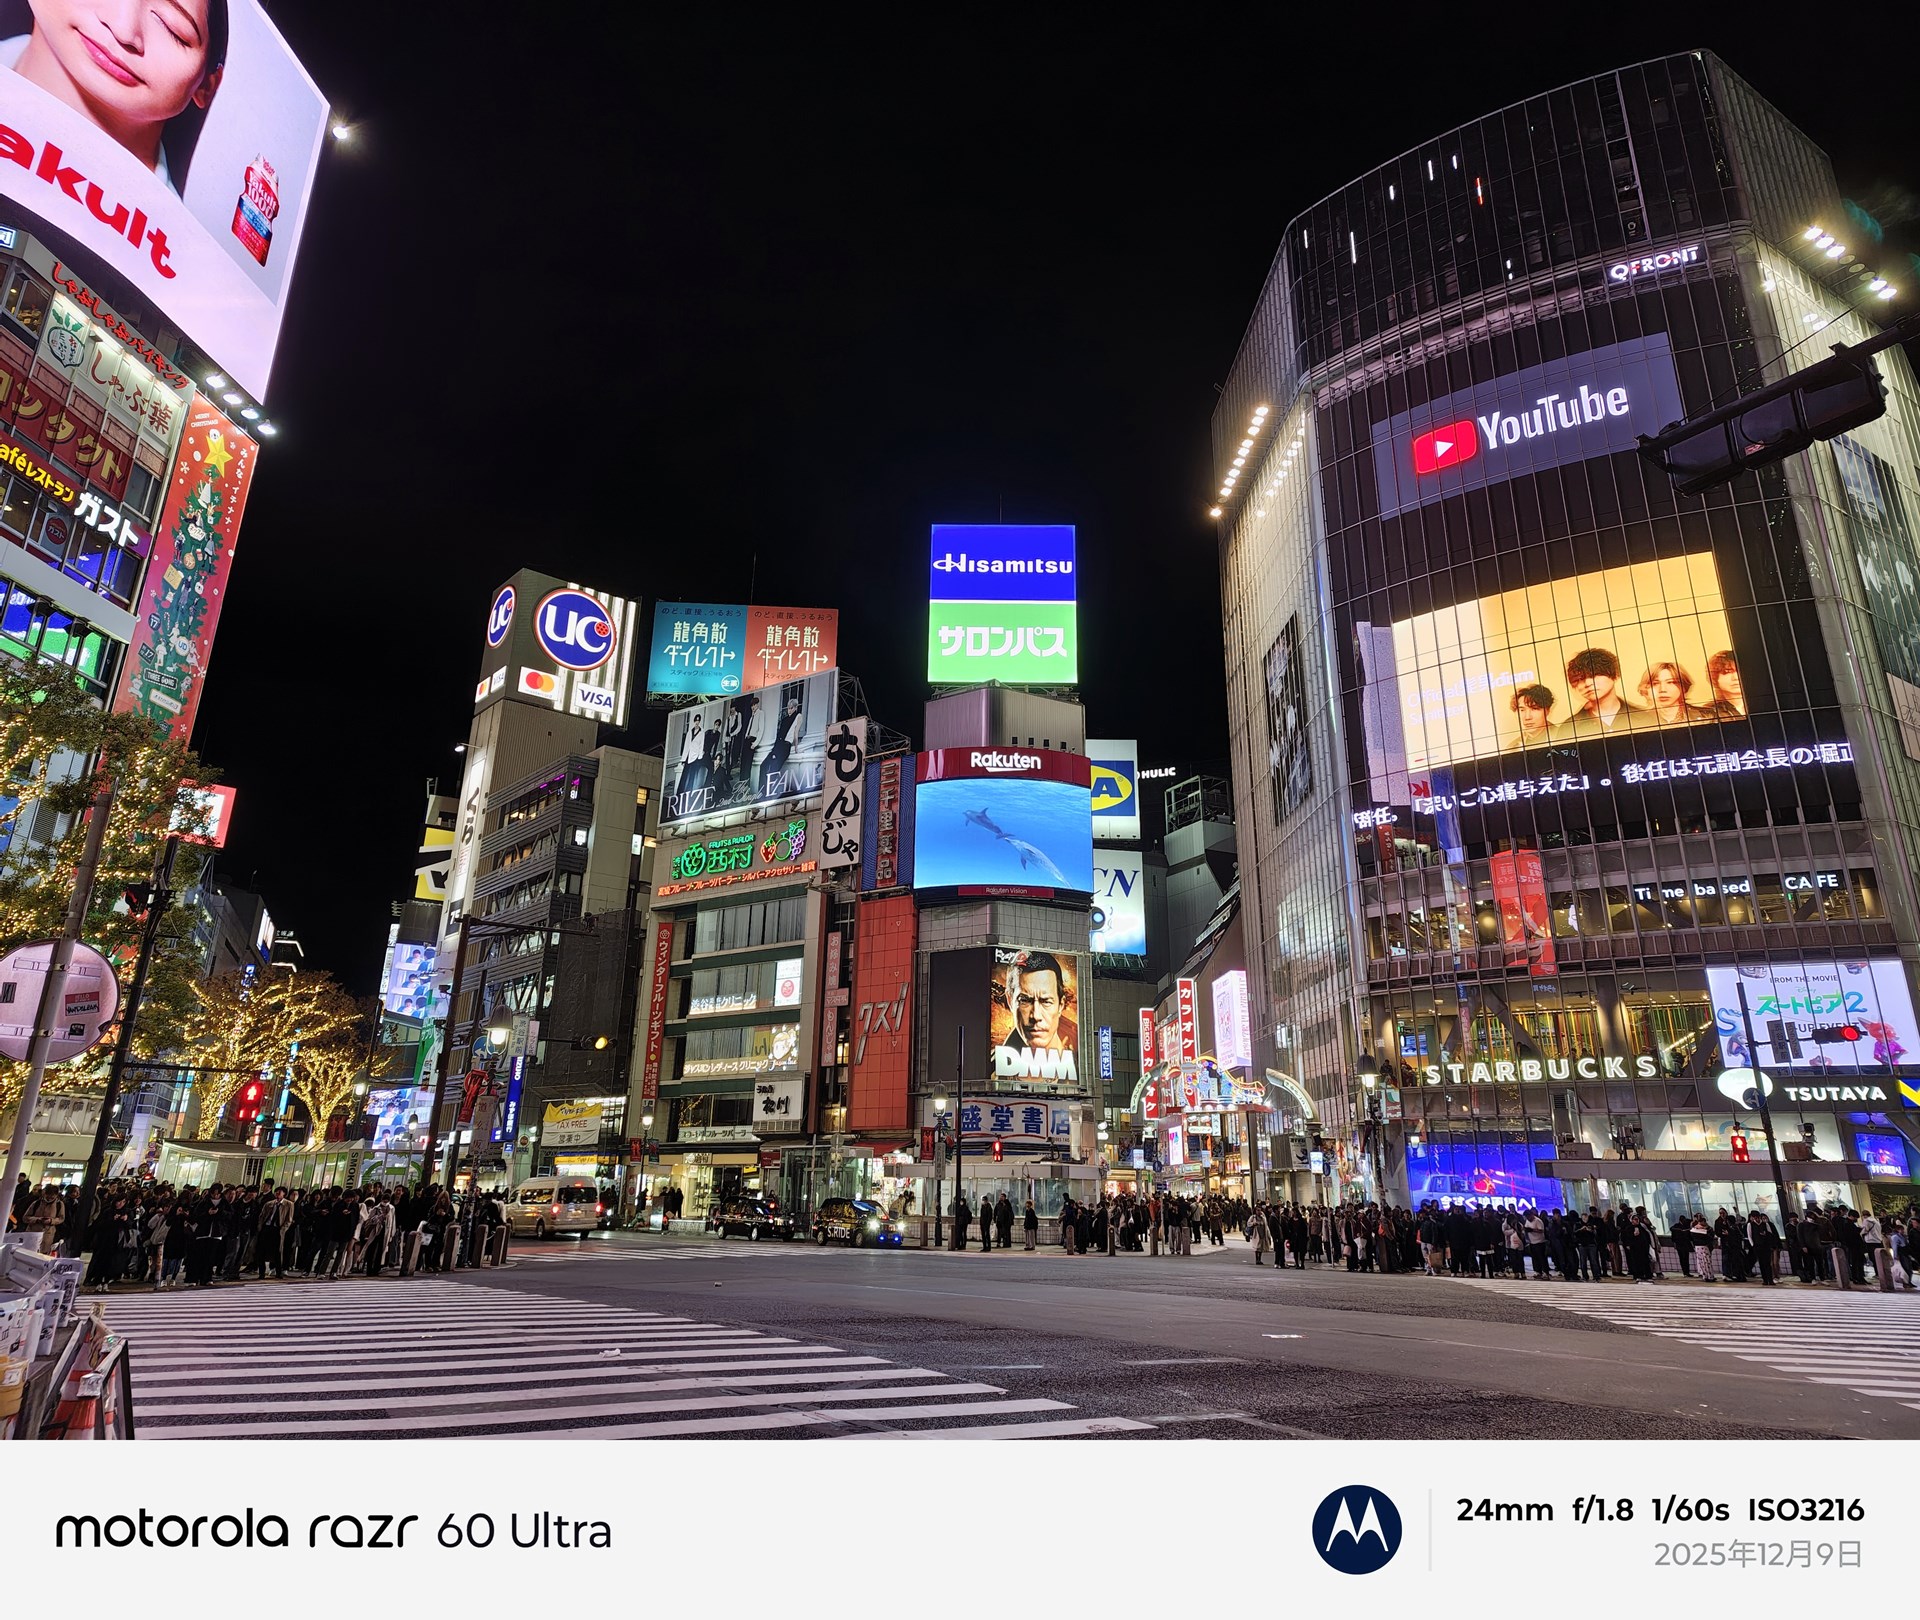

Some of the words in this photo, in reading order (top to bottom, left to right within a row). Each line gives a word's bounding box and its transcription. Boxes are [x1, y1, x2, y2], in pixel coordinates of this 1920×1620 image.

[1610, 246, 1698, 281] QFRONT
[52, 261, 190, 390] しゃぶしゃぶバイキング
[91, 350, 173, 435] しゃぶ葉
[1478, 384, 1630, 450] YouTube
[74, 491, 139, 547] ガスト
[933, 553, 1073, 574] Hisamitsu
[673, 620, 728, 644] 龍角散
[765, 624, 819, 648] 龍角散
[938, 625, 1068, 657] サロンパス
[578, 687, 613, 710] VISA
[970, 751, 1042, 773] Rakuten
[1142, 766, 1176, 781] HULIC
[766, 768, 823, 797] FAME
[823, 724, 863, 861] もんじゃ
[666, 786, 716, 818] RIIZE
[707, 845, 752, 873] 西村
[986, 887, 1008, 895] Rakuten
[1010, 887, 1028, 895] Vision
[1635, 886, 1684, 900] Time
[1694, 880, 1751, 897] based
[1785, 874, 1839, 890] CAFE
[1795, 975, 1811, 984] THE
[1812, 974, 1839, 983] MOVIE
[650, 941, 668, 1052] ウィンターフルーツギフト
[1180, 987, 1193, 1049] カラオケ
[994, 1044, 1078, 1081] DMM
[1426, 1056, 1657, 1085] STARBUCKS
[1783, 1085, 1888, 1102] TSUTAYA
[571, 1120, 588, 1129] FREE
[827, 1226, 851, 1239] S.RIDE
